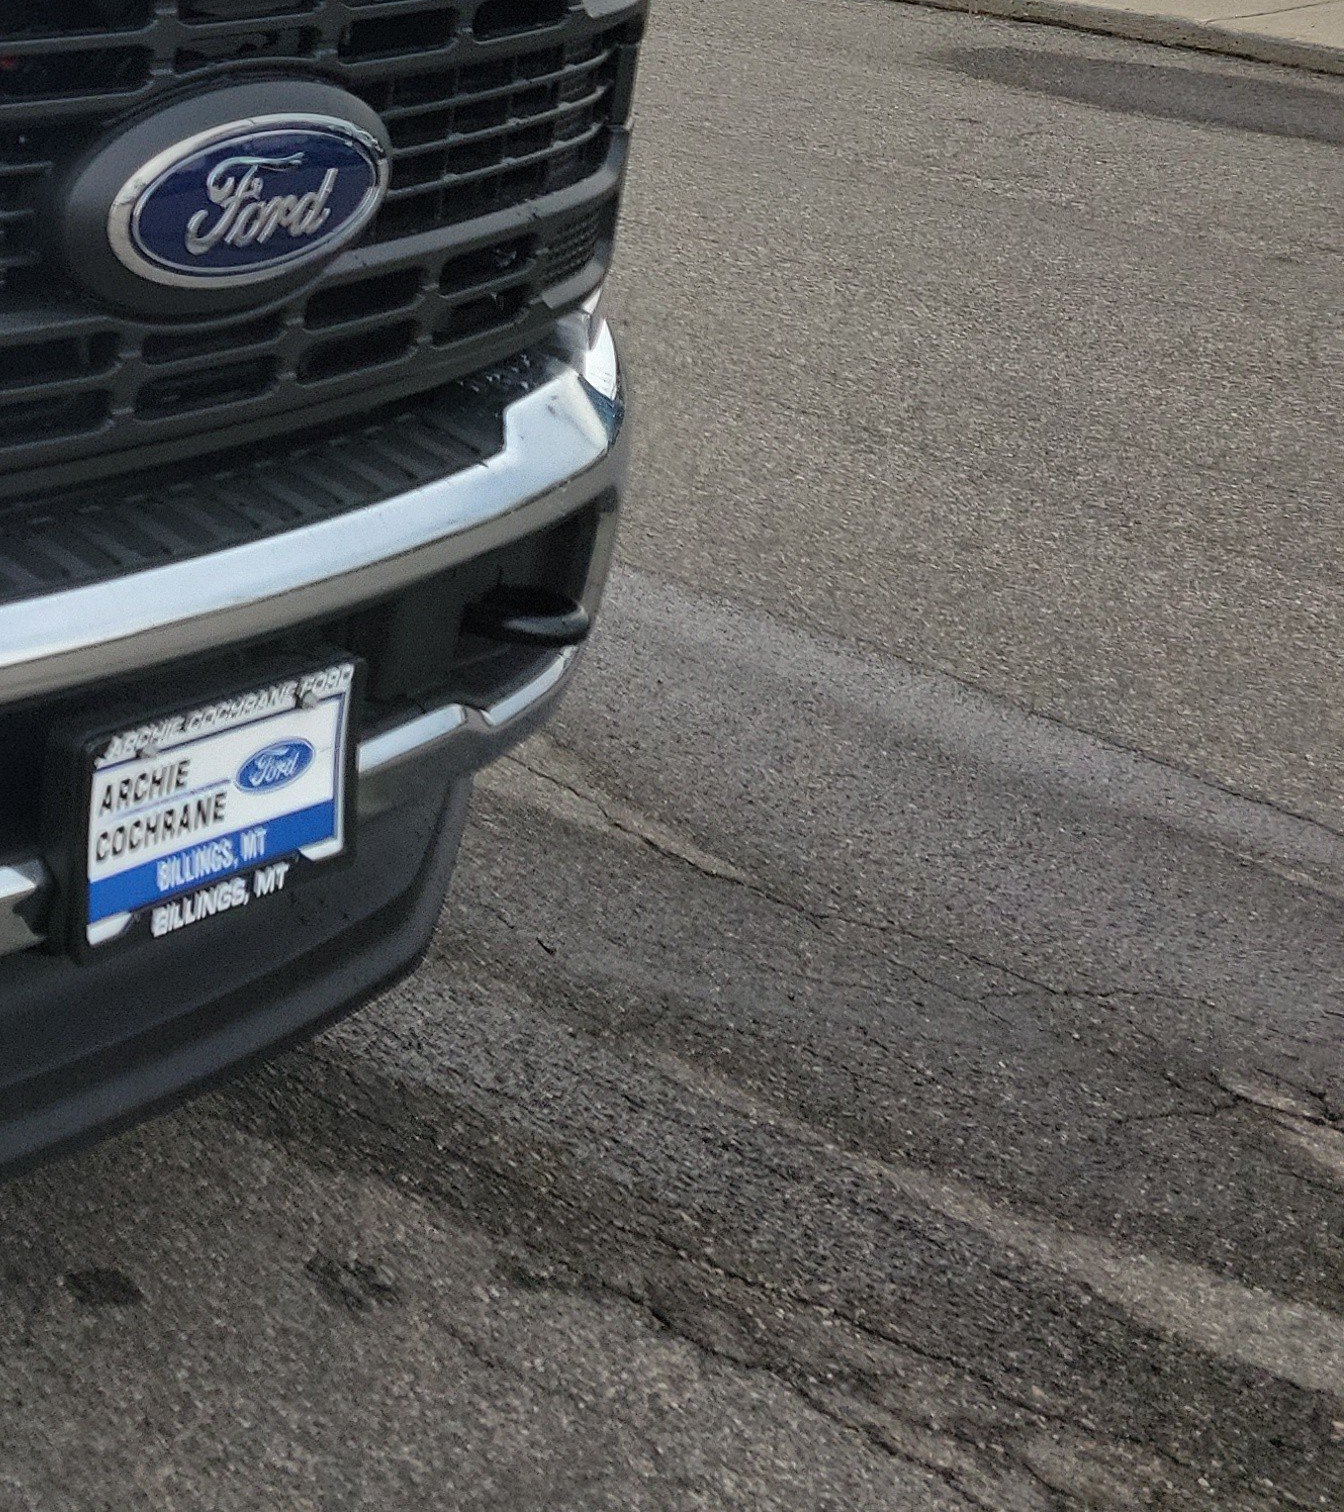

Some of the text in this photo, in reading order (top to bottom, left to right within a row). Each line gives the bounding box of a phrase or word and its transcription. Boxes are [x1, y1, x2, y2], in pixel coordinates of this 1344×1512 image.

[184, 151, 340, 256] Ford
[186, 681, 299, 731] COCHRANE
[299, 663, 355, 699] FORD
[98, 758, 191, 817] ARCHIE
[248, 747, 299, 788] Ford
[95, 791, 228, 863] COCHRANE
[156, 828, 267, 891] BILLINGS, MT
[150, 861, 290, 938] BILLINGS, MT
